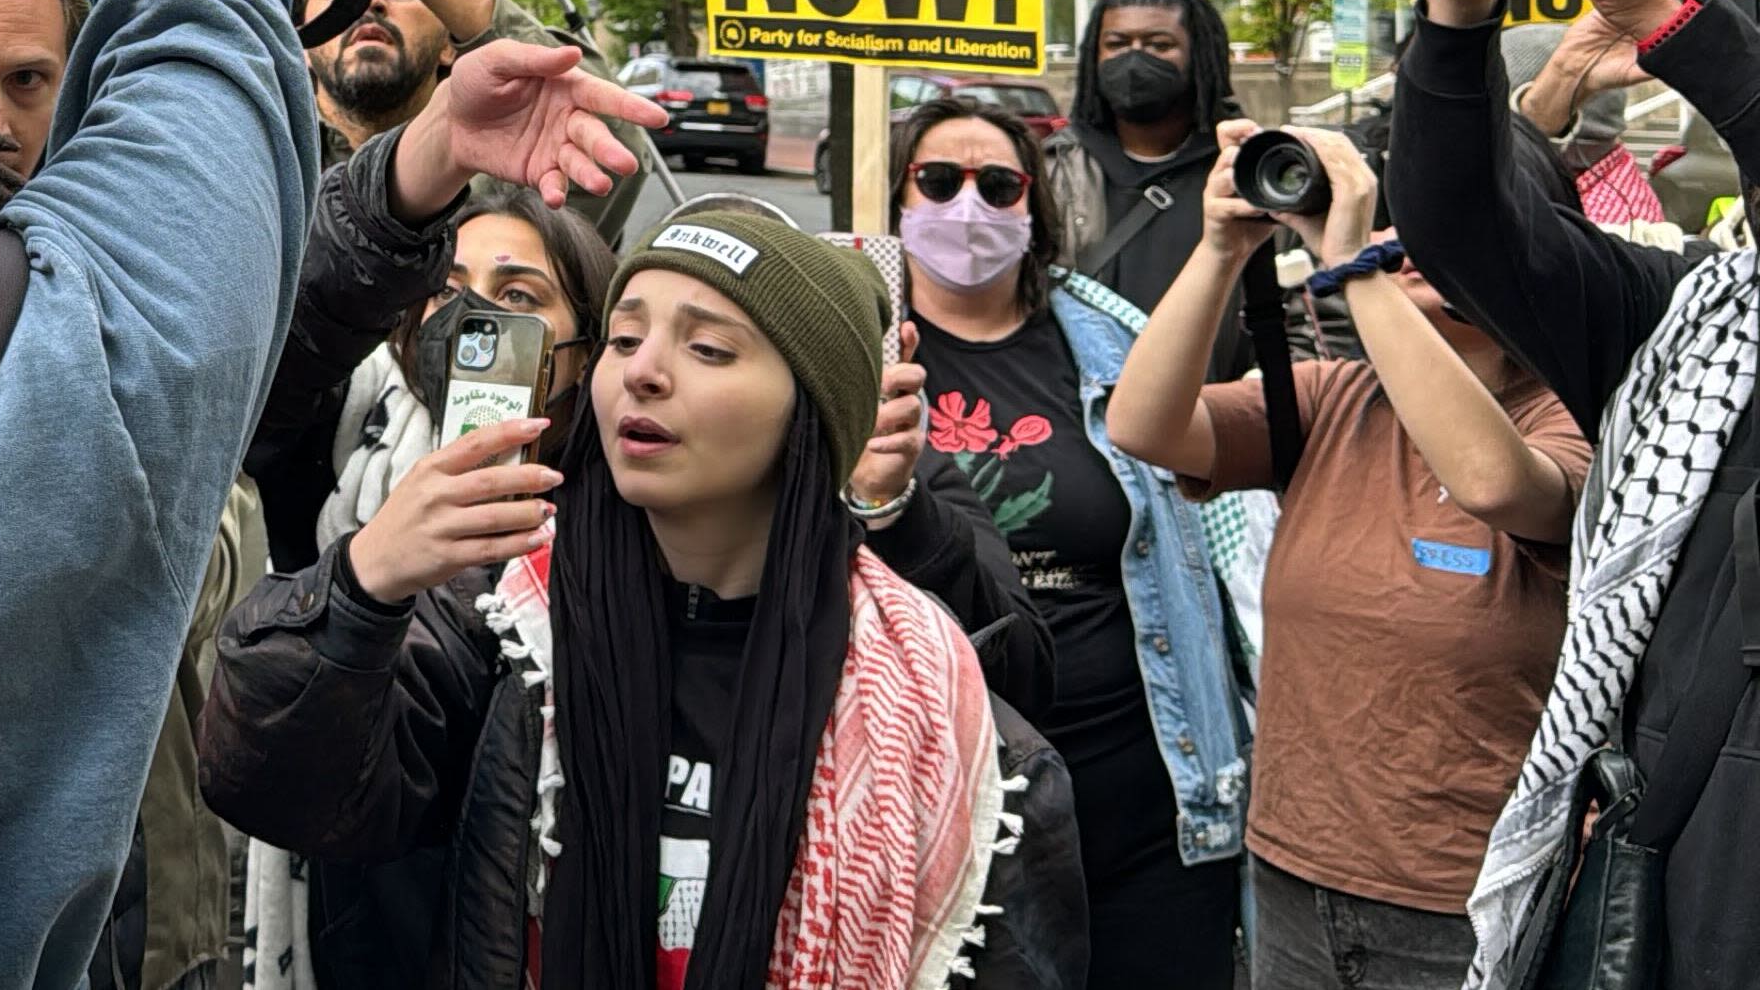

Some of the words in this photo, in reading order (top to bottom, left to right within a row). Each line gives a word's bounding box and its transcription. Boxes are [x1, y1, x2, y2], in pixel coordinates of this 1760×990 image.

[749, 27, 793, 48] Party
[796, 30, 821, 46] for
[825, 31, 903, 52] Socialism
[907, 33, 941, 53] and
[944, 36, 1031, 59] Liberation
